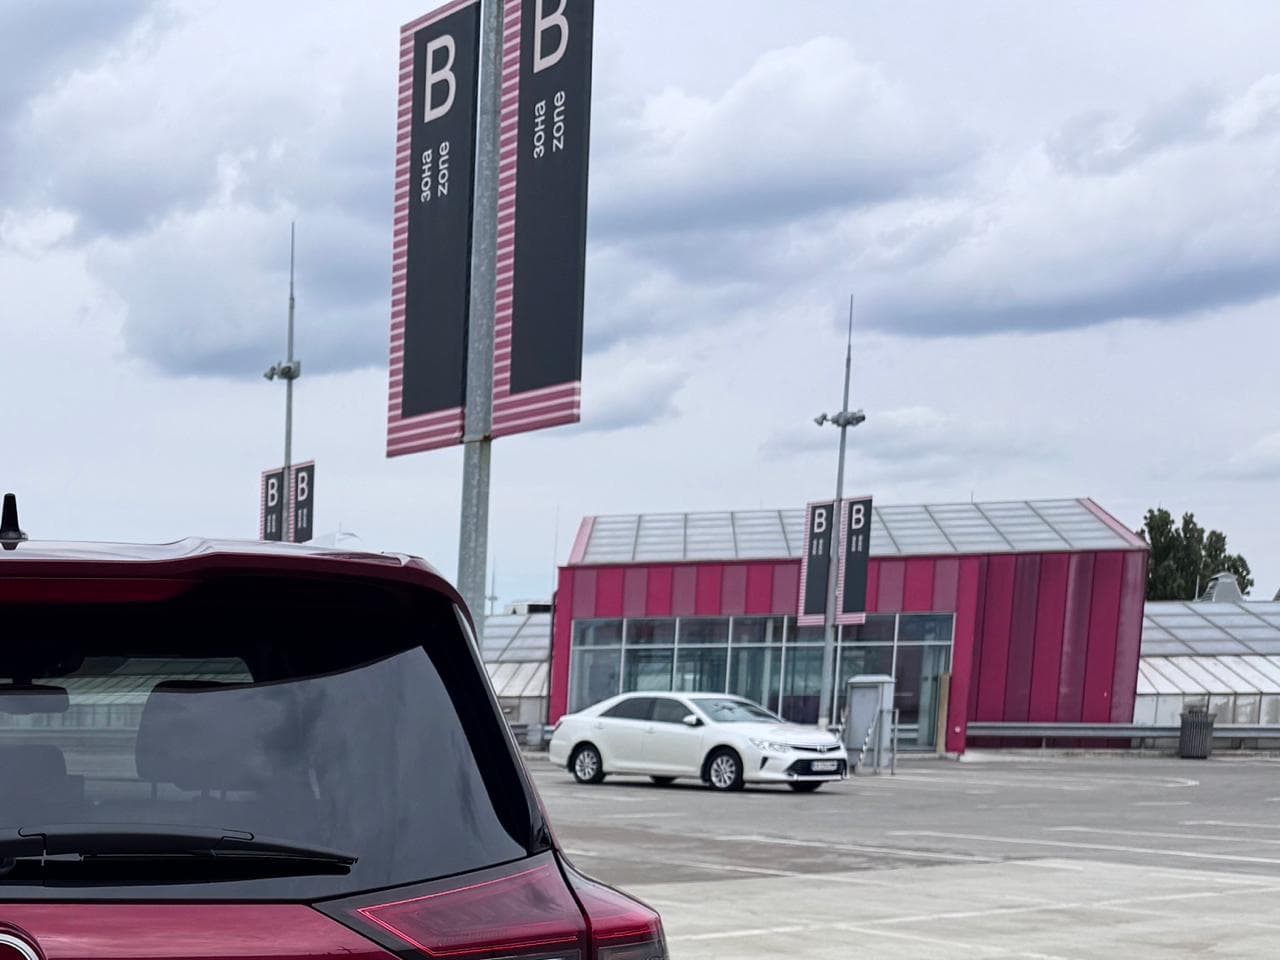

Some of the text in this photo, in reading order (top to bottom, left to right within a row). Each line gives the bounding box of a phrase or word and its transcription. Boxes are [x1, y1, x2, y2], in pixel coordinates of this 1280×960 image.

[533, 0, 569, 74] B
[424, 34, 456, 123] B
[533, 100, 546, 159] зона
[552, 91, 566, 152] zone
[421, 149, 433, 202] зона
[437, 141, 450, 197] zone
[268, 478, 278, 507] B
[297, 472, 308, 501] B
[814, 508, 826, 533] B
[851, 503, 865, 530] B
